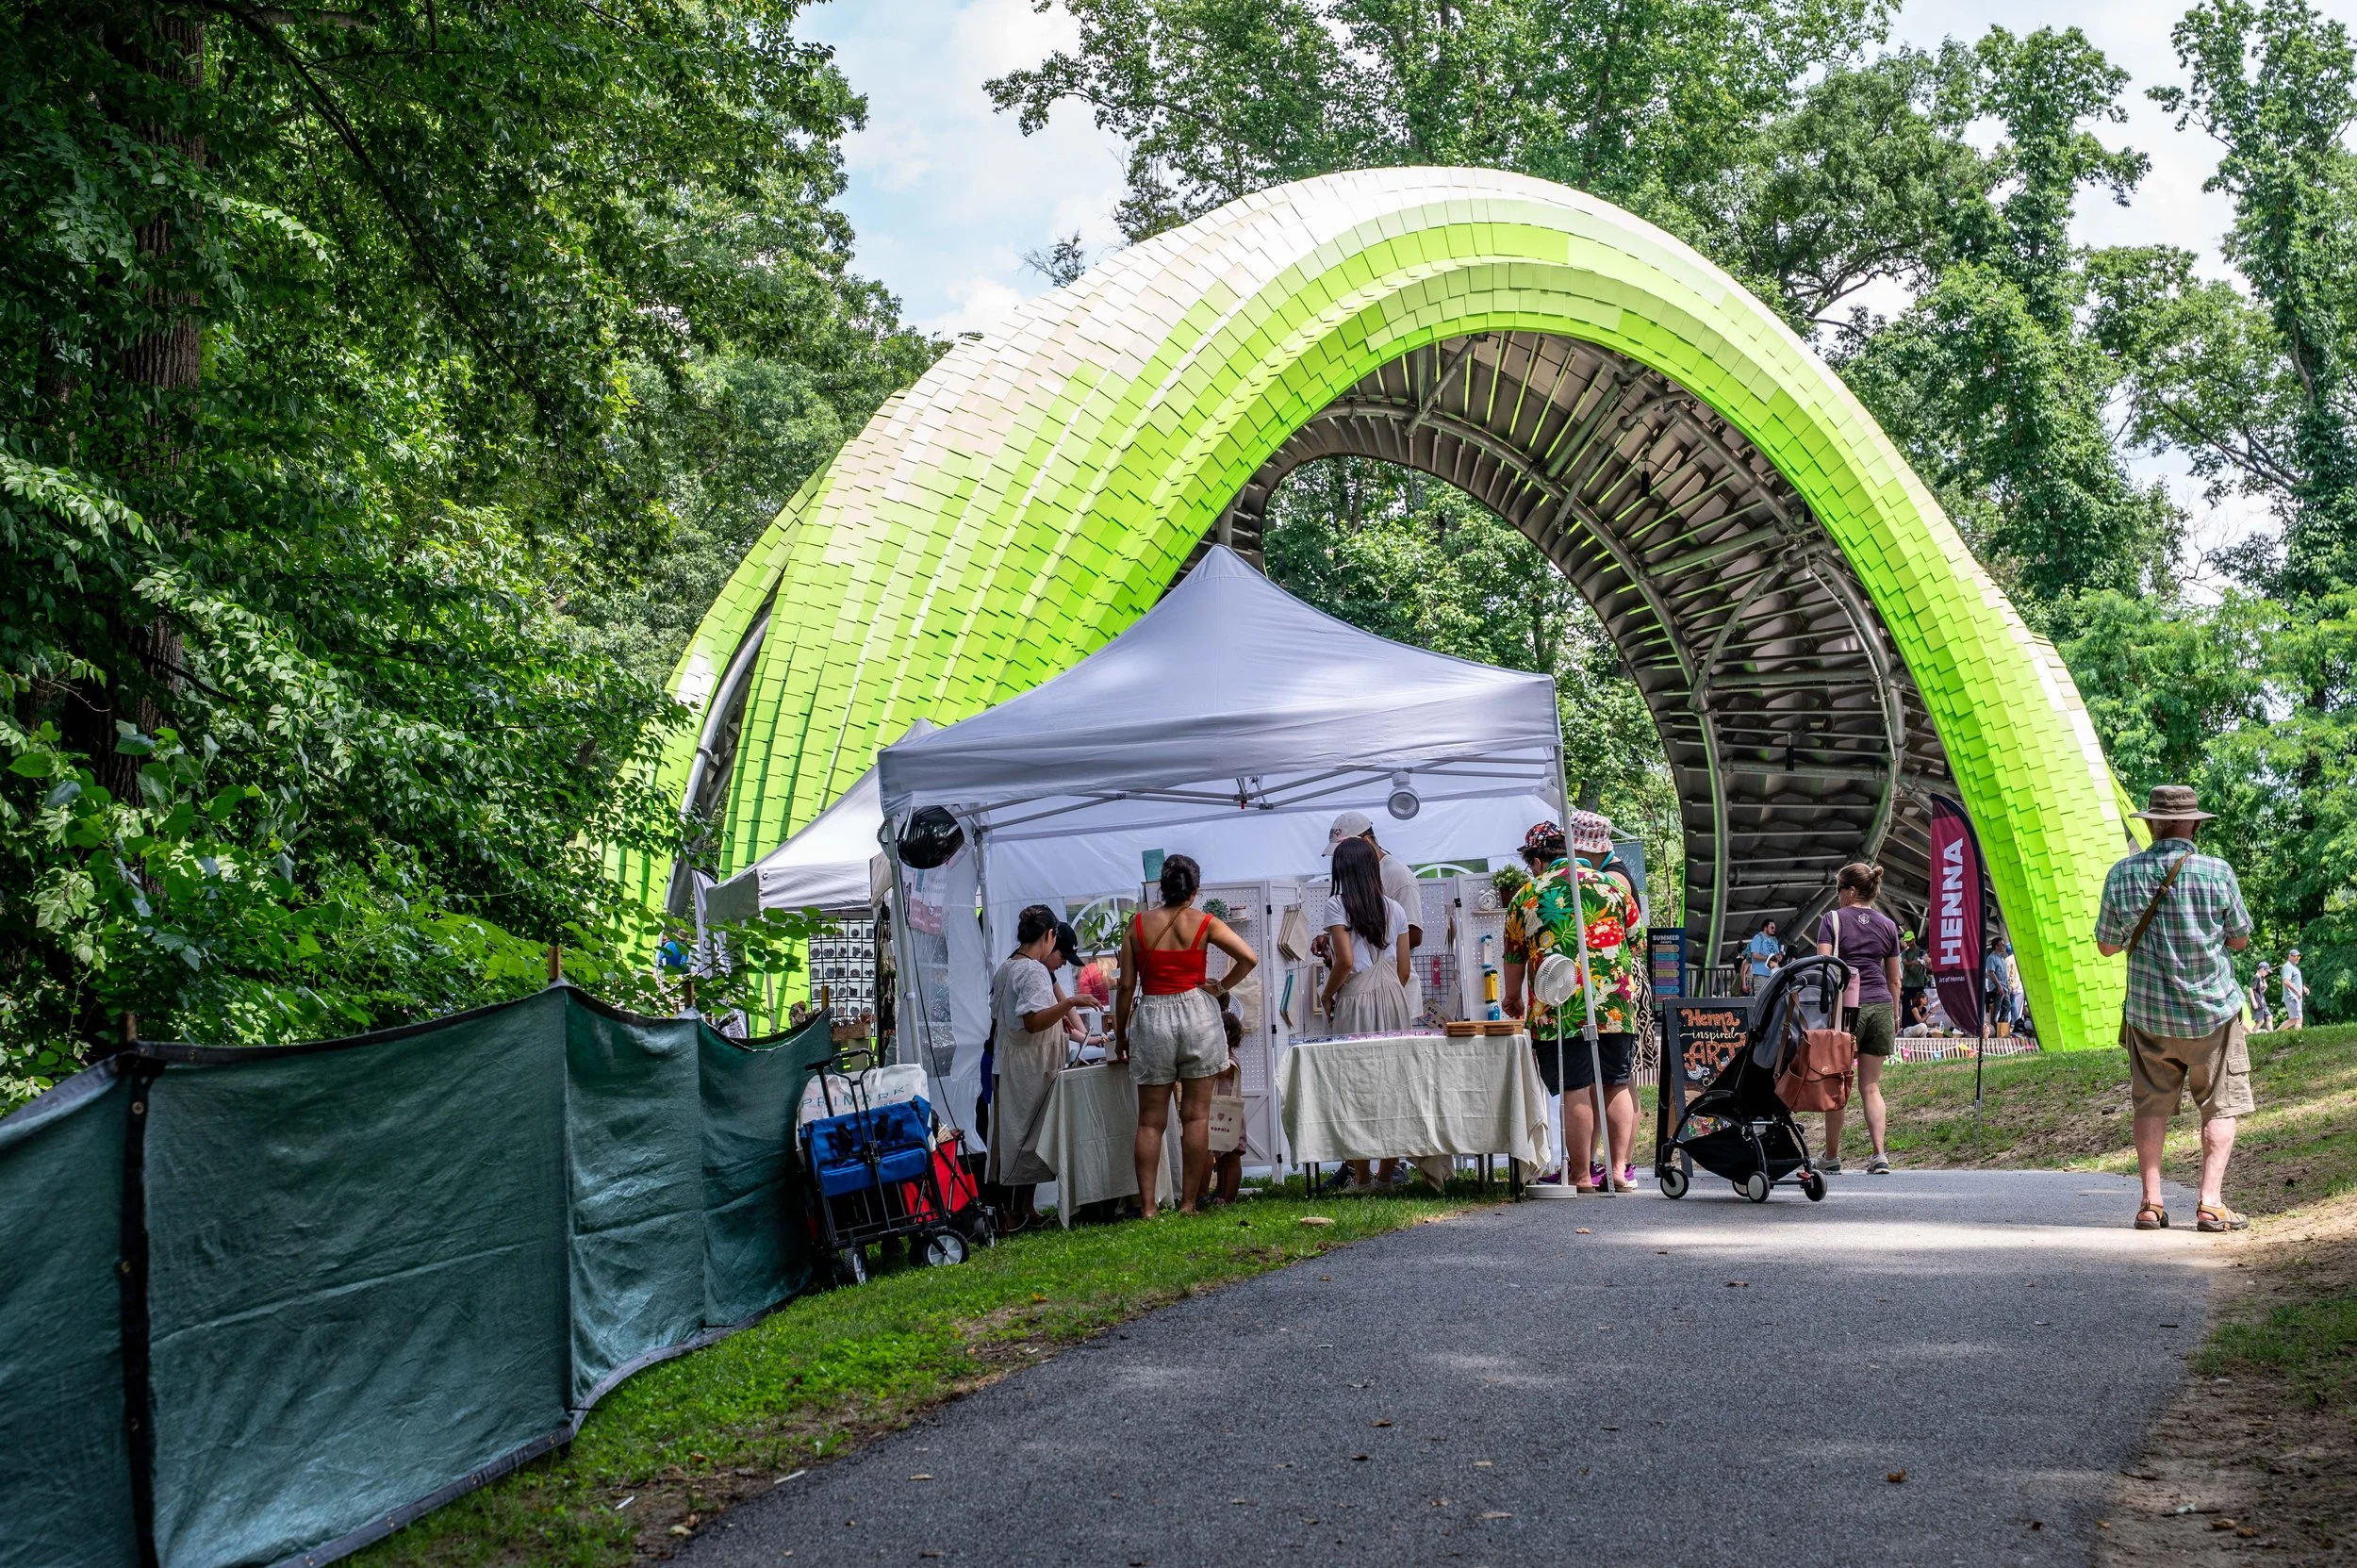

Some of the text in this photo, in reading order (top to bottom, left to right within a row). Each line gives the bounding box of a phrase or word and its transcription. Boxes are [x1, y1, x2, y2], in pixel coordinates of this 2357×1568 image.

[1940, 837, 1963, 965] HENNA
[1680, 1008, 1740, 1032] Henna
[1683, 1033, 1746, 1071] ART
